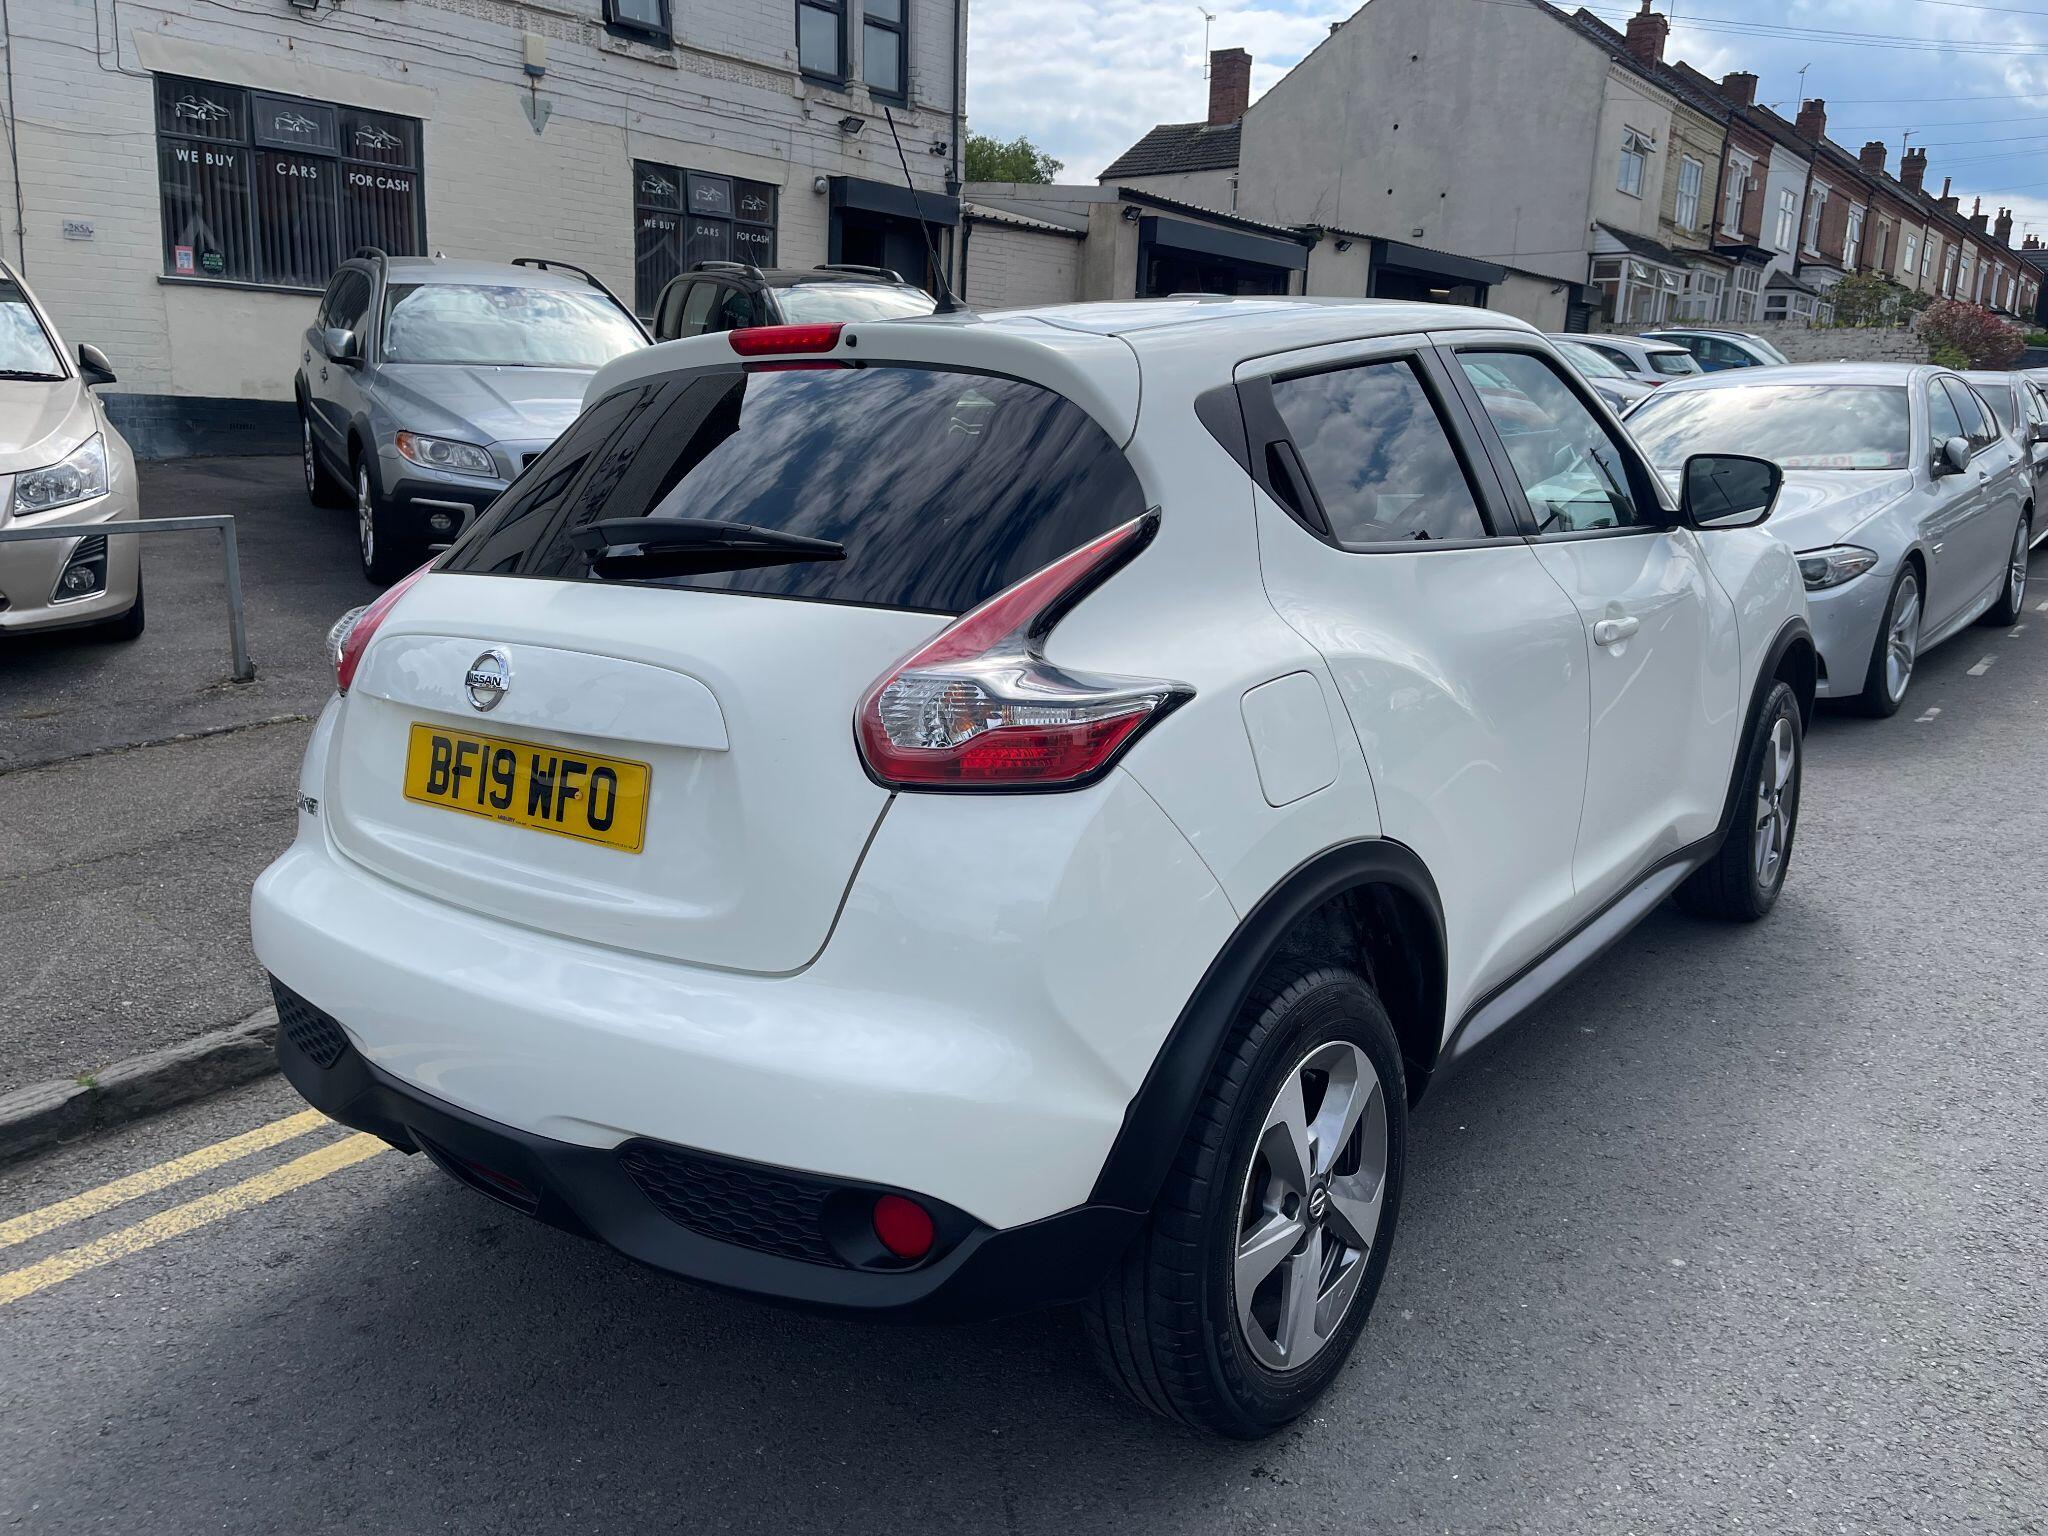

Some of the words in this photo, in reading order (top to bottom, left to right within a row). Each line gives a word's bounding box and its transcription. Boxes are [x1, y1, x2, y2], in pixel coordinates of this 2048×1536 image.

[175, 149, 199, 163] WE
[206, 152, 234, 168] BUY
[276, 162, 318, 179] CARS
[349, 172, 374, 187] FOR
[376, 176, 410, 192] CASH
[644, 218, 657, 229] WE
[659, 220, 676, 231] BUY
[696, 226, 719, 237] CARS
[736, 231, 750, 241] FOR
[751, 233, 770, 244] CASH
[466, 672, 502, 687] NISSAN
[427, 735, 517, 810] BF19
[527, 754, 618, 832] WFO
